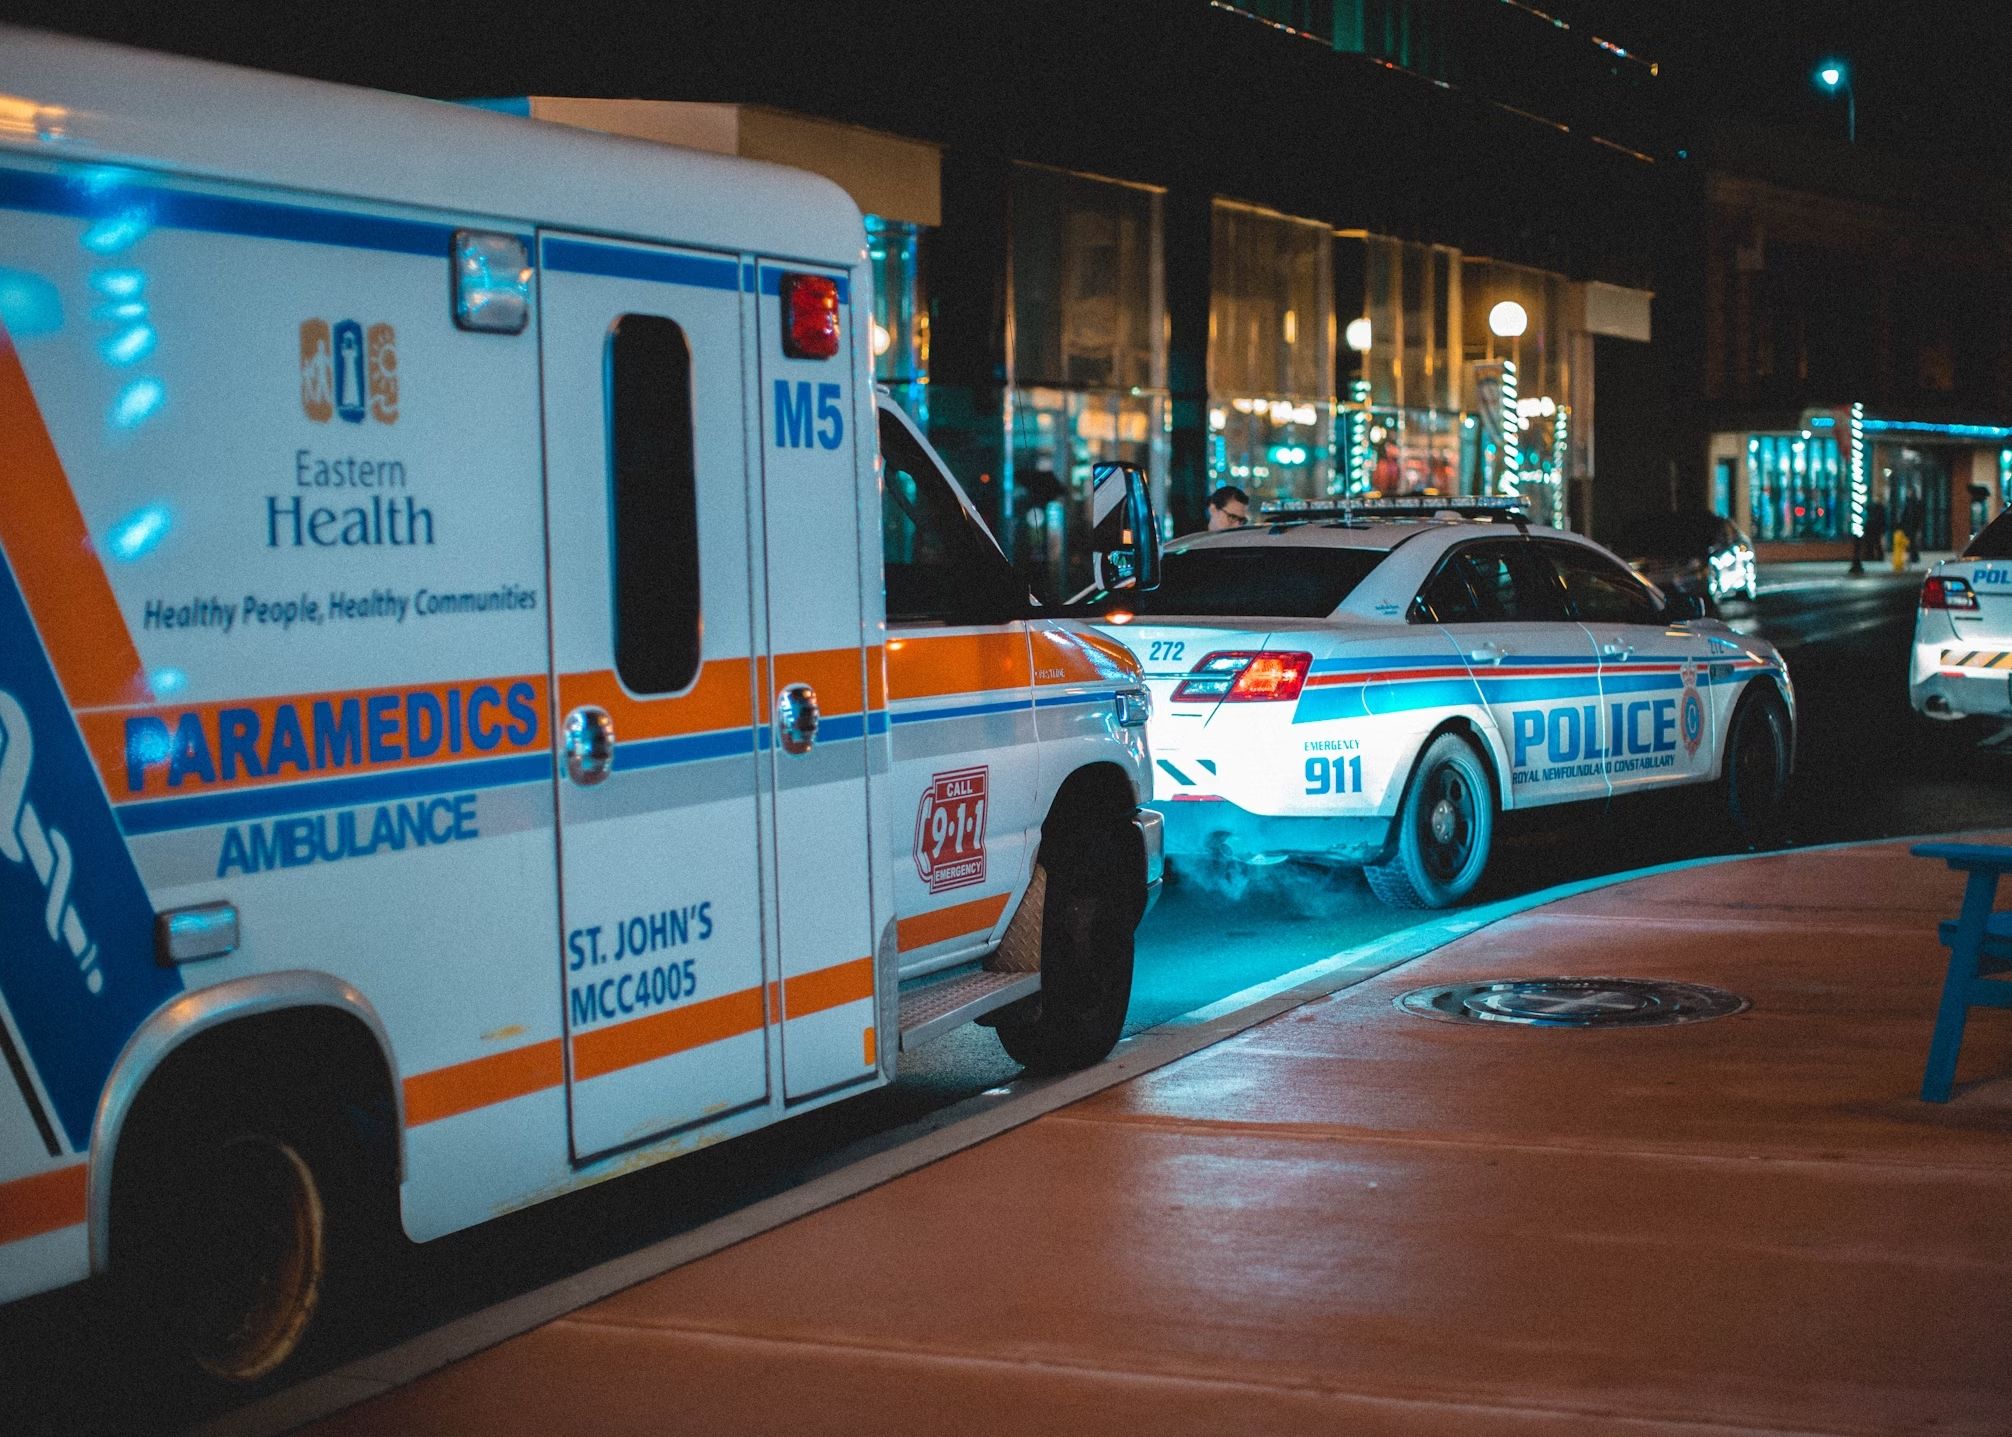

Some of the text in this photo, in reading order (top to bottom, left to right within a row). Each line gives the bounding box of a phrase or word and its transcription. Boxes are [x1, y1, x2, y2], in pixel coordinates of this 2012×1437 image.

[774, 379, 843, 450] M5
[296, 450, 406, 487] Eastern
[266, 496, 435, 547] Health
[144, 584, 537, 634] Healthy People, Healthy Communities
[1149, 640, 1185, 661] 272
[125, 682, 538, 792] PARAMEDICS
[1304, 739, 1361, 751] EMERGENCY
[1512, 698, 1677, 768] POLICE
[946, 780, 973, 797] CALL
[1305, 754, 1362, 795] 911
[1512, 754, 1676, 785] ROYAL NEWFOUNDLAND CONSTABULARY
[217, 794, 479, 878] AMBULANCE
[934, 861, 982, 882] EMERGENCY
[568, 901, 713, 972] ST. JOHN'S
[571, 958, 697, 1027] MCC4005
